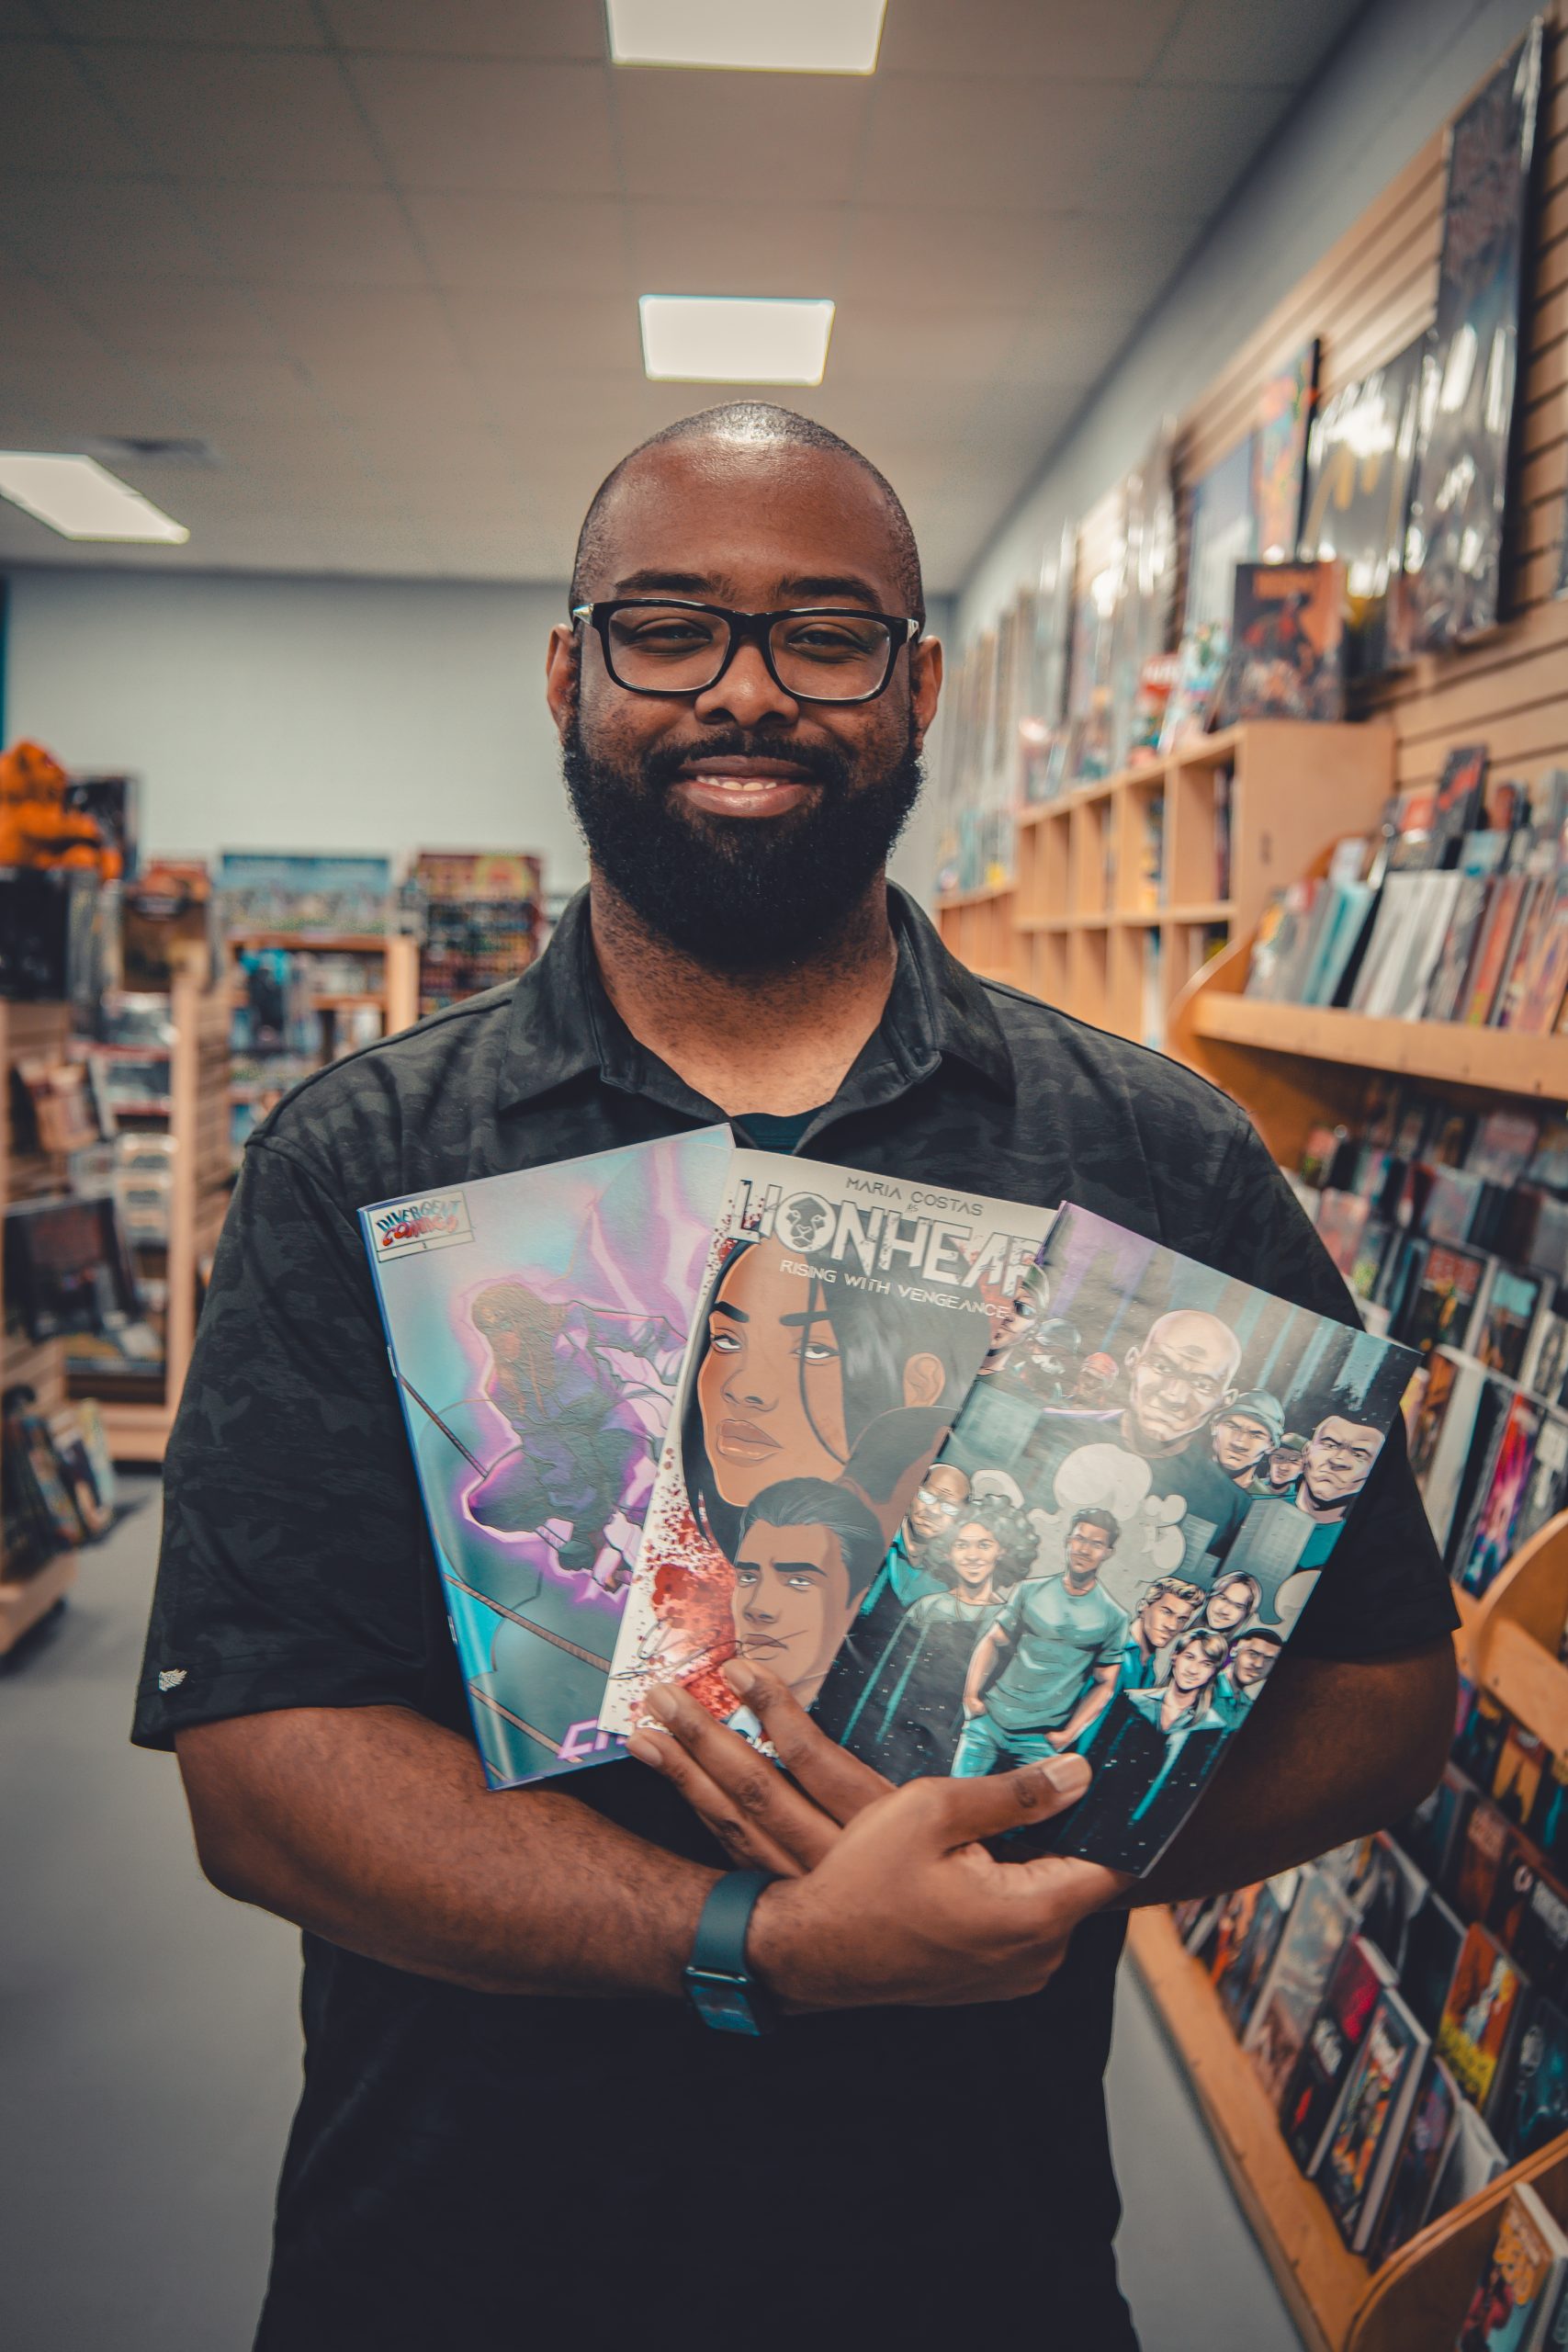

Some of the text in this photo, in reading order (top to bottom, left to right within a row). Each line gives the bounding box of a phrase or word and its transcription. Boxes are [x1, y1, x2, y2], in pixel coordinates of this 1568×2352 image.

[846, 1177, 984, 1216] MARIA COSTAS
[728, 1179, 1044, 1297] LIONHEAR
[779, 1260, 1010, 1319] RISING WITH VENGEANCE
